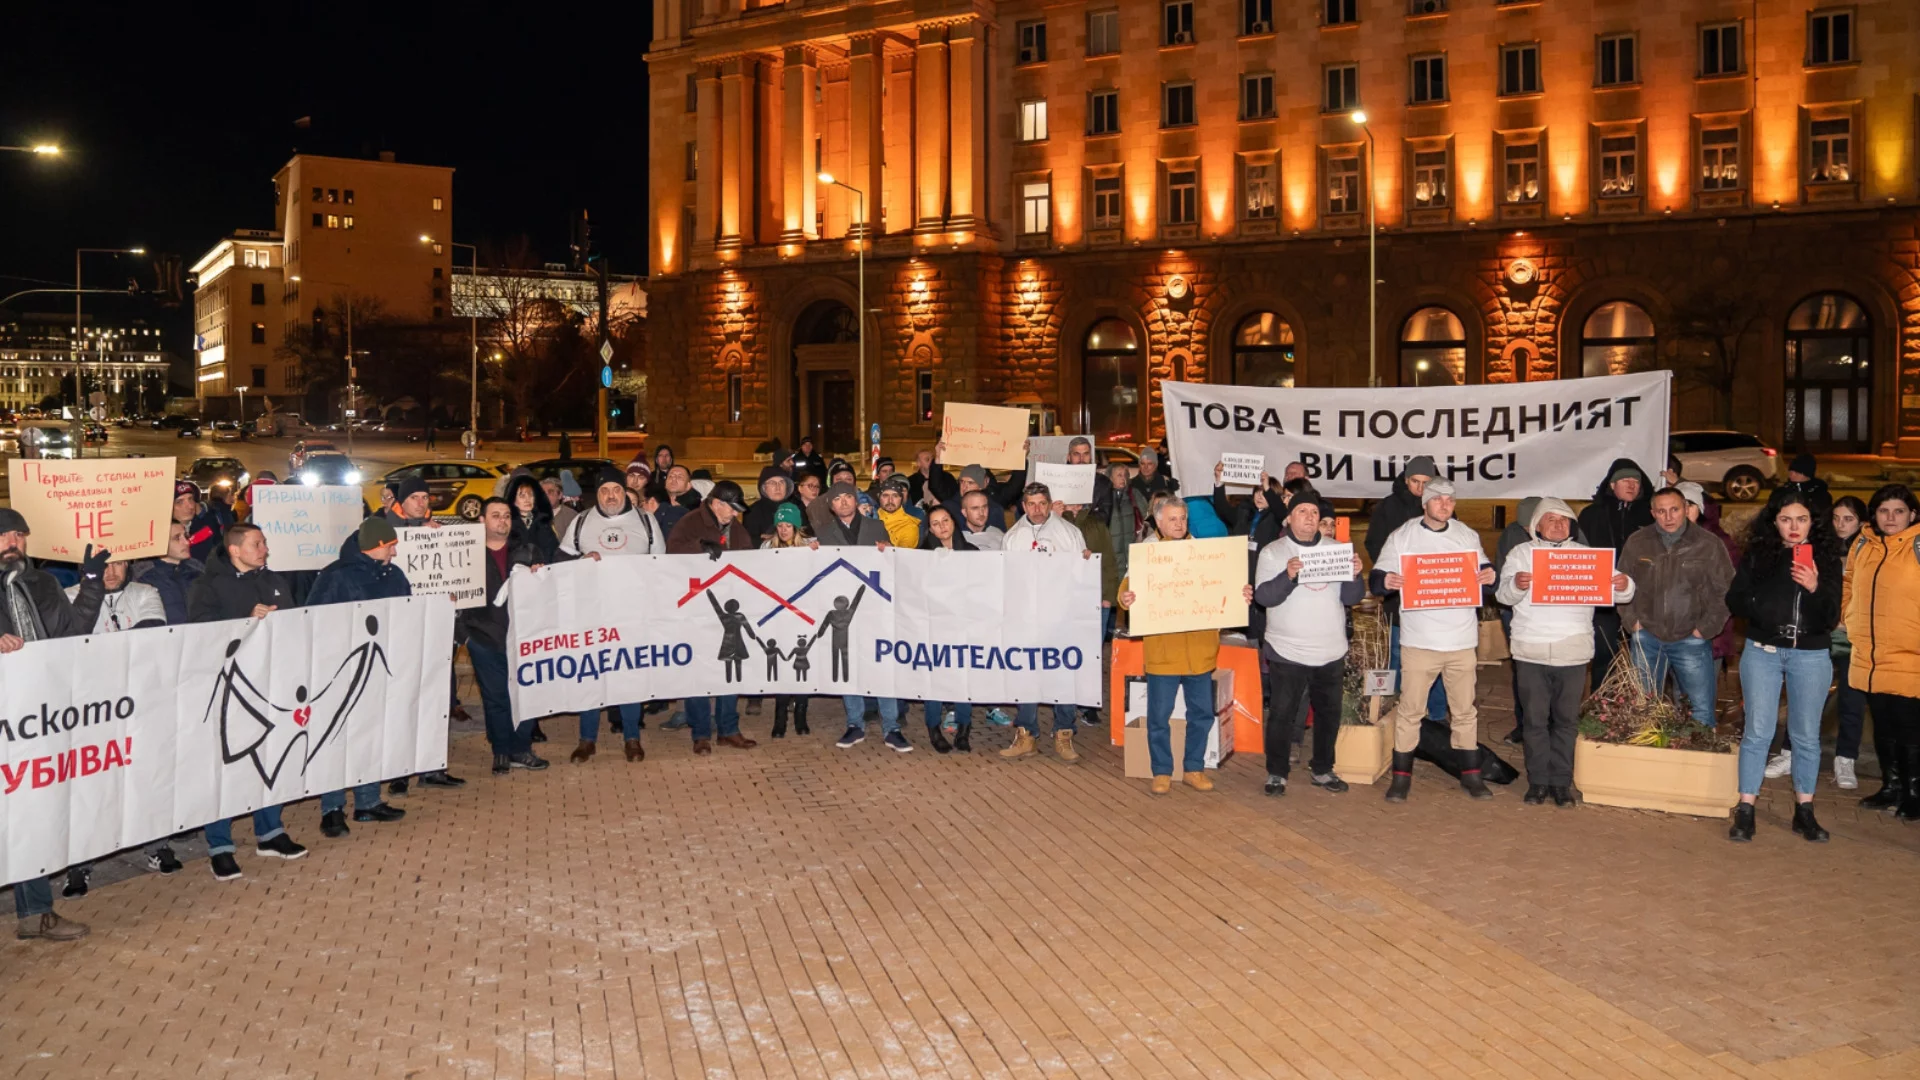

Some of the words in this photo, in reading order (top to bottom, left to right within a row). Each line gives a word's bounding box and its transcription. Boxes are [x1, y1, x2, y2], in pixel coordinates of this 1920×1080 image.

[1180, 401, 1284, 435] ТОВА
[1303, 410, 1321, 436] Е
[1338, 395, 1641, 444] ПОСЛЕДНИЯТ
[1300, 452, 1353, 481] ВИ
[75, 509, 115, 539] НЕ
[1416, 557, 1463, 565] Родителите
[1548, 551, 1597, 560] Родителите
[519, 633, 580, 657] ВРЕМЕ
[584, 630, 594, 647] Е
[598, 626, 621, 643] ЗА
[875, 639, 1083, 671] РОДИТЕЛСТВО
[516, 643, 693, 687] СПОДЕЛЕНО
[0, 736, 133, 795] УБИВА!
